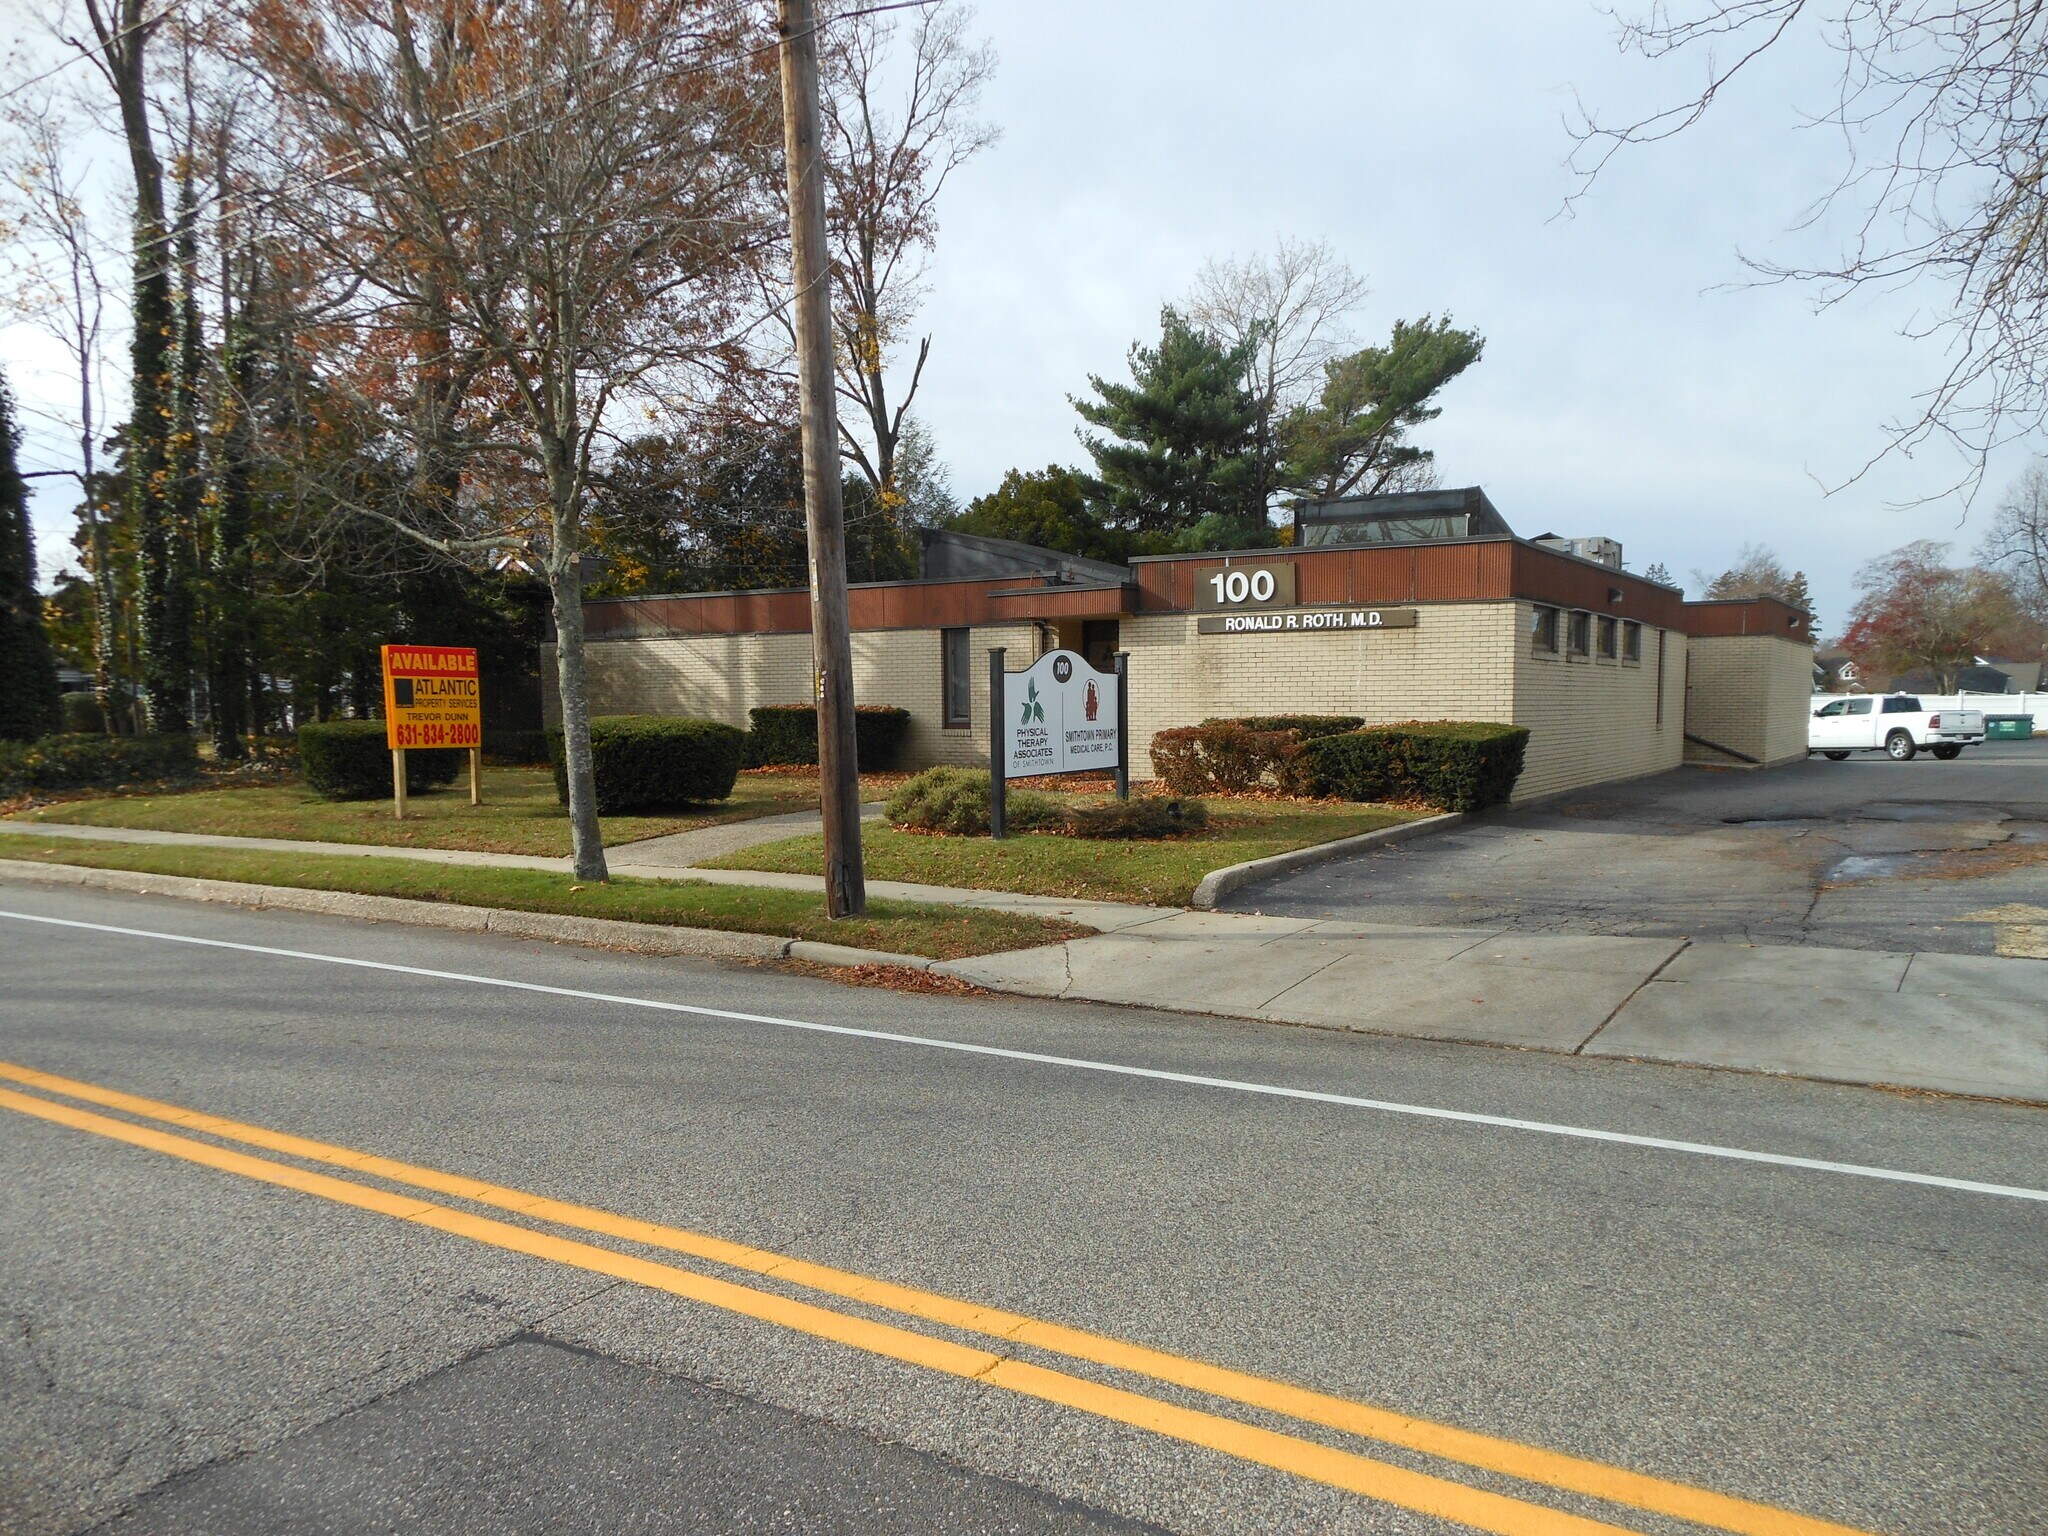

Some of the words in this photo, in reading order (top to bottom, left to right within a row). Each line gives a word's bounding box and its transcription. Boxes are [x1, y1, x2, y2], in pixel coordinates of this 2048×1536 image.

[1210, 570, 1275, 603] 100
[1225, 615, 1283, 631] RONALD
[1286, 615, 1299, 628] R.
[1303, 613, 1348, 628] ROTH,
[392, 653, 475, 671] AVAILABLE
[1056, 662, 1069, 675] 100
[415, 679, 477, 695] ATLANTIC
[415, 698, 446, 708] PROPERTY
[449, 699, 477, 708] SERVICES
[397, 724, 478, 745] 631-834-2800
[1016, 728, 1048, 738] PHYSICAL
[1065, 730, 1095, 743] SMITHTOWN
[1095, 728, 1117, 740] PRIMARY
[1017, 737, 1048, 748] THERAPY
[1070, 744, 1090, 754] MEDICAL
[1090, 743, 1104, 754] CARE,
[1013, 747, 1053, 760] ASSOCIATES
[1012, 761, 1020, 769] OF
[1022, 759, 1054, 768] SMITHTOWN
